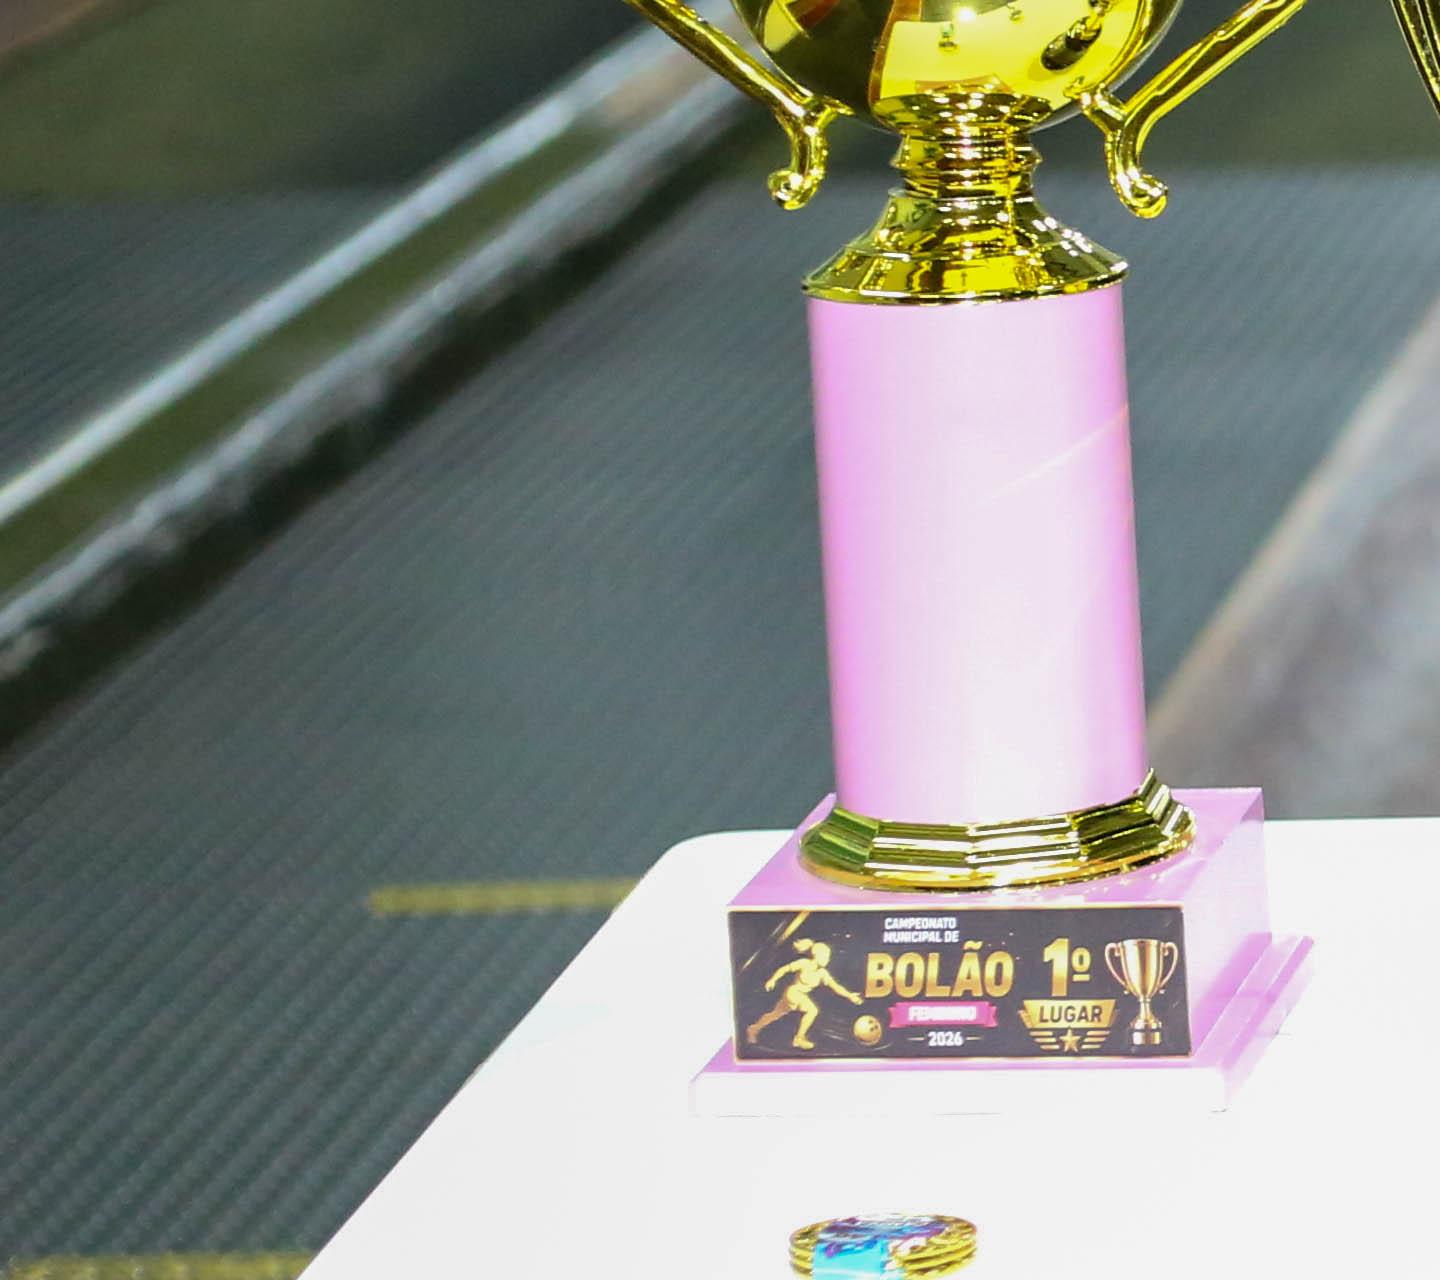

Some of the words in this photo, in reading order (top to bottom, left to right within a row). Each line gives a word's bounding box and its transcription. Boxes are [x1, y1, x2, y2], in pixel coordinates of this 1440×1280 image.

[884, 917, 957, 930] CAMPEONATO
[883, 930, 942, 943] MUNICIPAL
[944, 930, 959, 943] DE
[864, 940, 1015, 998] BOLÃO
[1039, 1005, 1103, 1023] LUGAR
[928, 1032, 963, 1047] 2026
